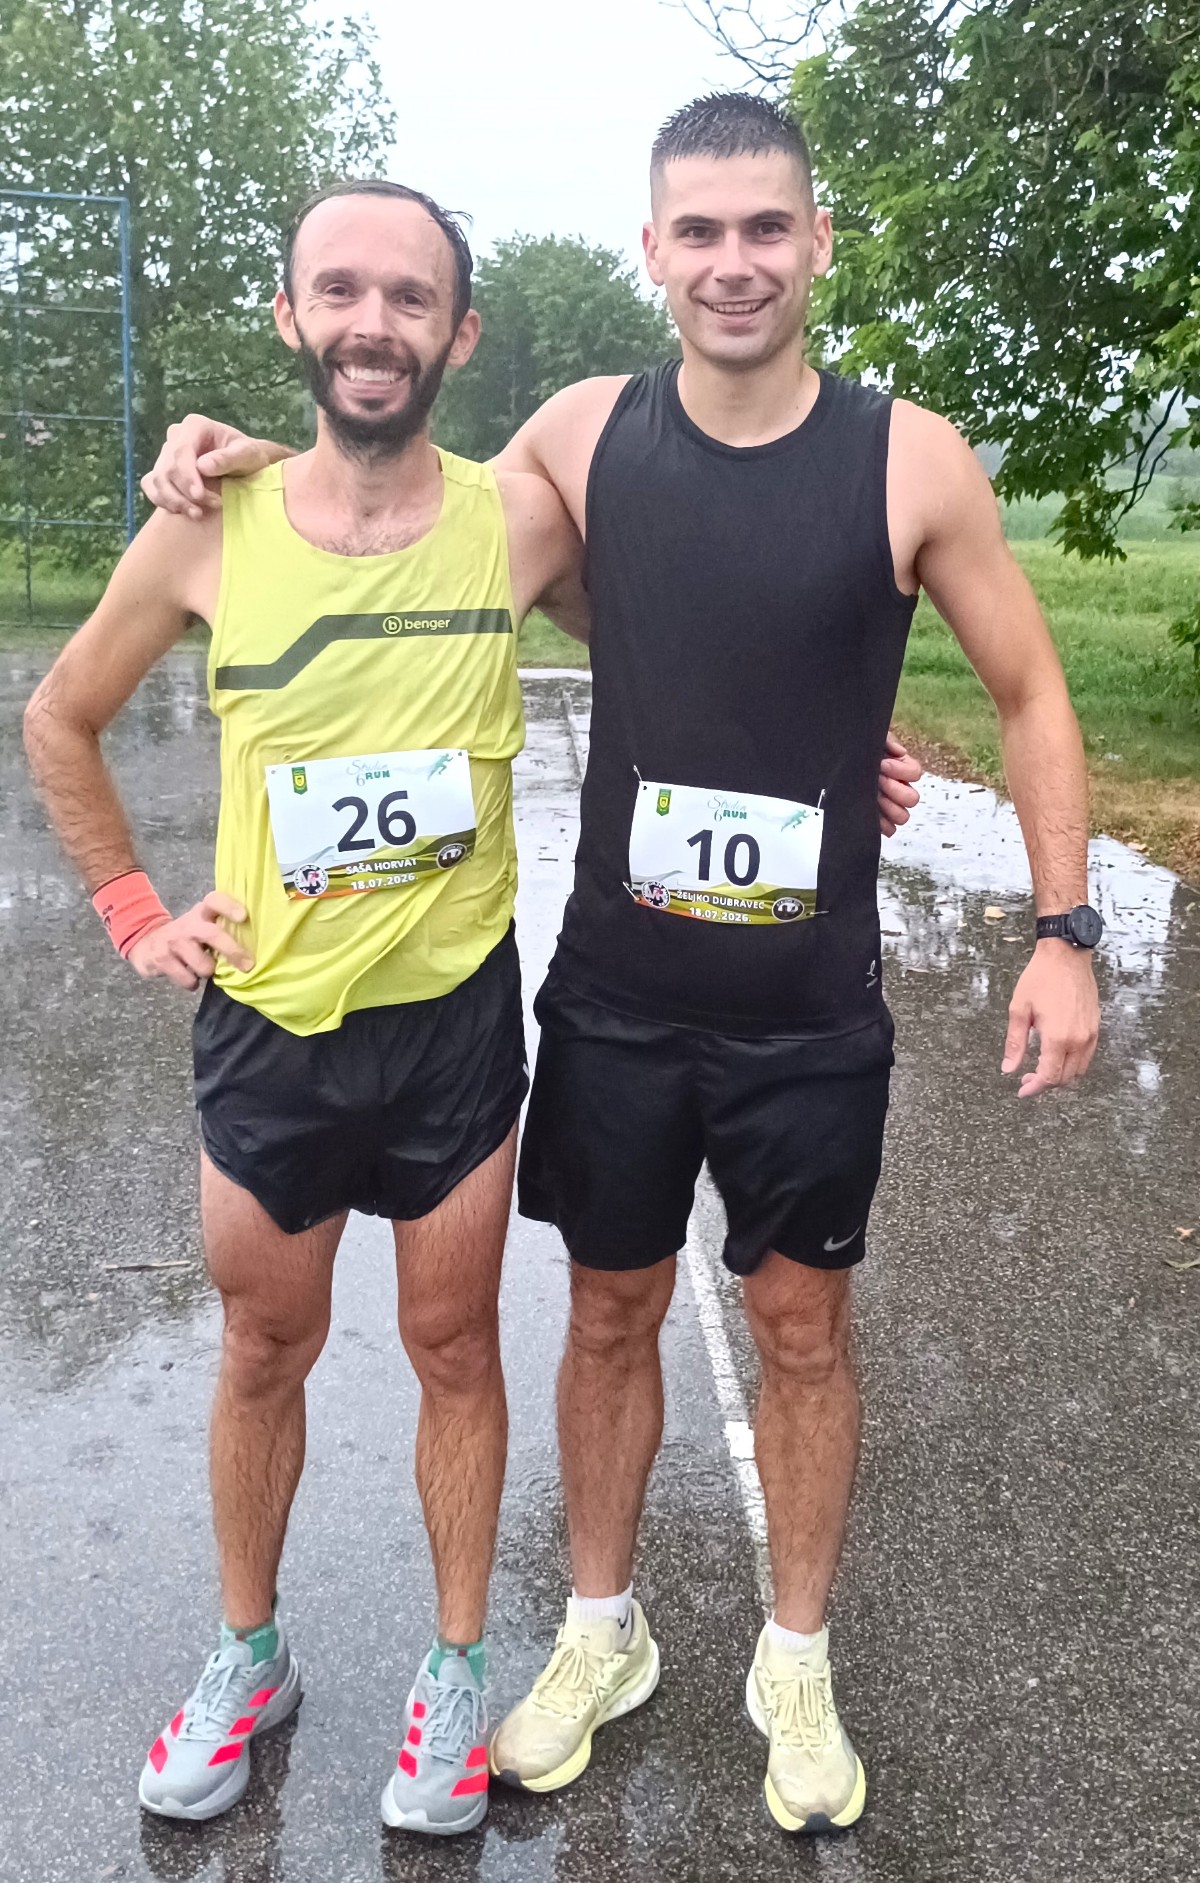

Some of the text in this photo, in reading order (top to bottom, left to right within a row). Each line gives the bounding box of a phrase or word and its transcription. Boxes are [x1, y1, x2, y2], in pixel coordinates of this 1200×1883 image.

[404, 618, 451, 631] benger
[365, 769, 391, 780] RUN
[332, 790, 417, 852] 26
[722, 809, 748, 820] RUN
[345, 858, 417, 875] SAŠA HORVAT
[687, 829, 761, 887] 10
[351, 872, 419, 890] 18.07.2026.
[676, 889, 710, 903] ŽELJKO
[712, 896, 765, 909] DUBRAVEC
[689, 907, 752, 922] 18.07.2026.
